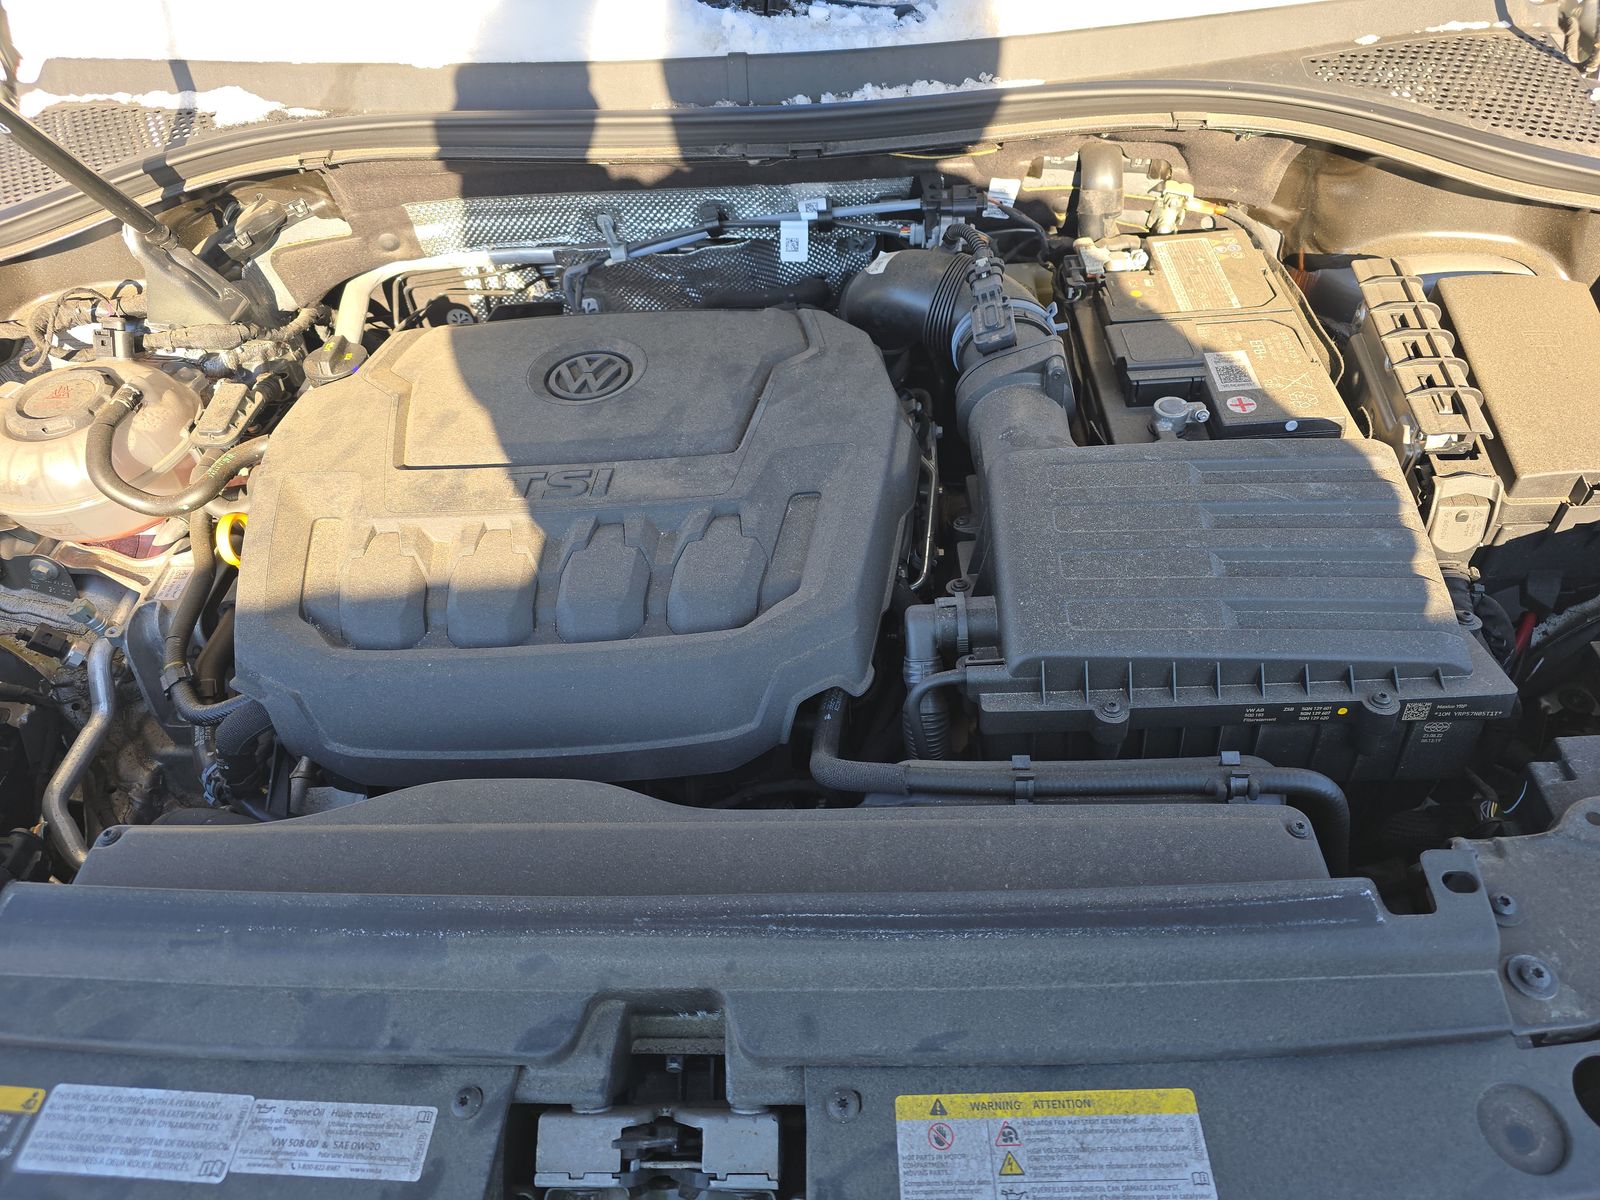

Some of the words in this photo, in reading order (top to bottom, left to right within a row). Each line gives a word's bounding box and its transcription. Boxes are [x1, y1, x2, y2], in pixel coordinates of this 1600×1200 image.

[544, 350, 634, 402] VW
[508, 467, 615, 499] TSI
[970, 1101, 1021, 1111] WARNING
[1033, 1098, 1092, 1109] ATTENTION
[284, 1106, 312, 1117] Engine
[312, 1107, 326, 1117] Oil
[331, 1108, 352, 1118] Huile
[354, 1110, 385, 1119] moteur
[271, 1138, 286, 1147] VW
[288, 1138, 305, 1147] 508
[305, 1139, 319, 1148] 00
[321, 1140, 328, 1149] &
[333, 1141, 350, 1150] SAE
[1121, 1184, 1148, 1192] DAMAGE
